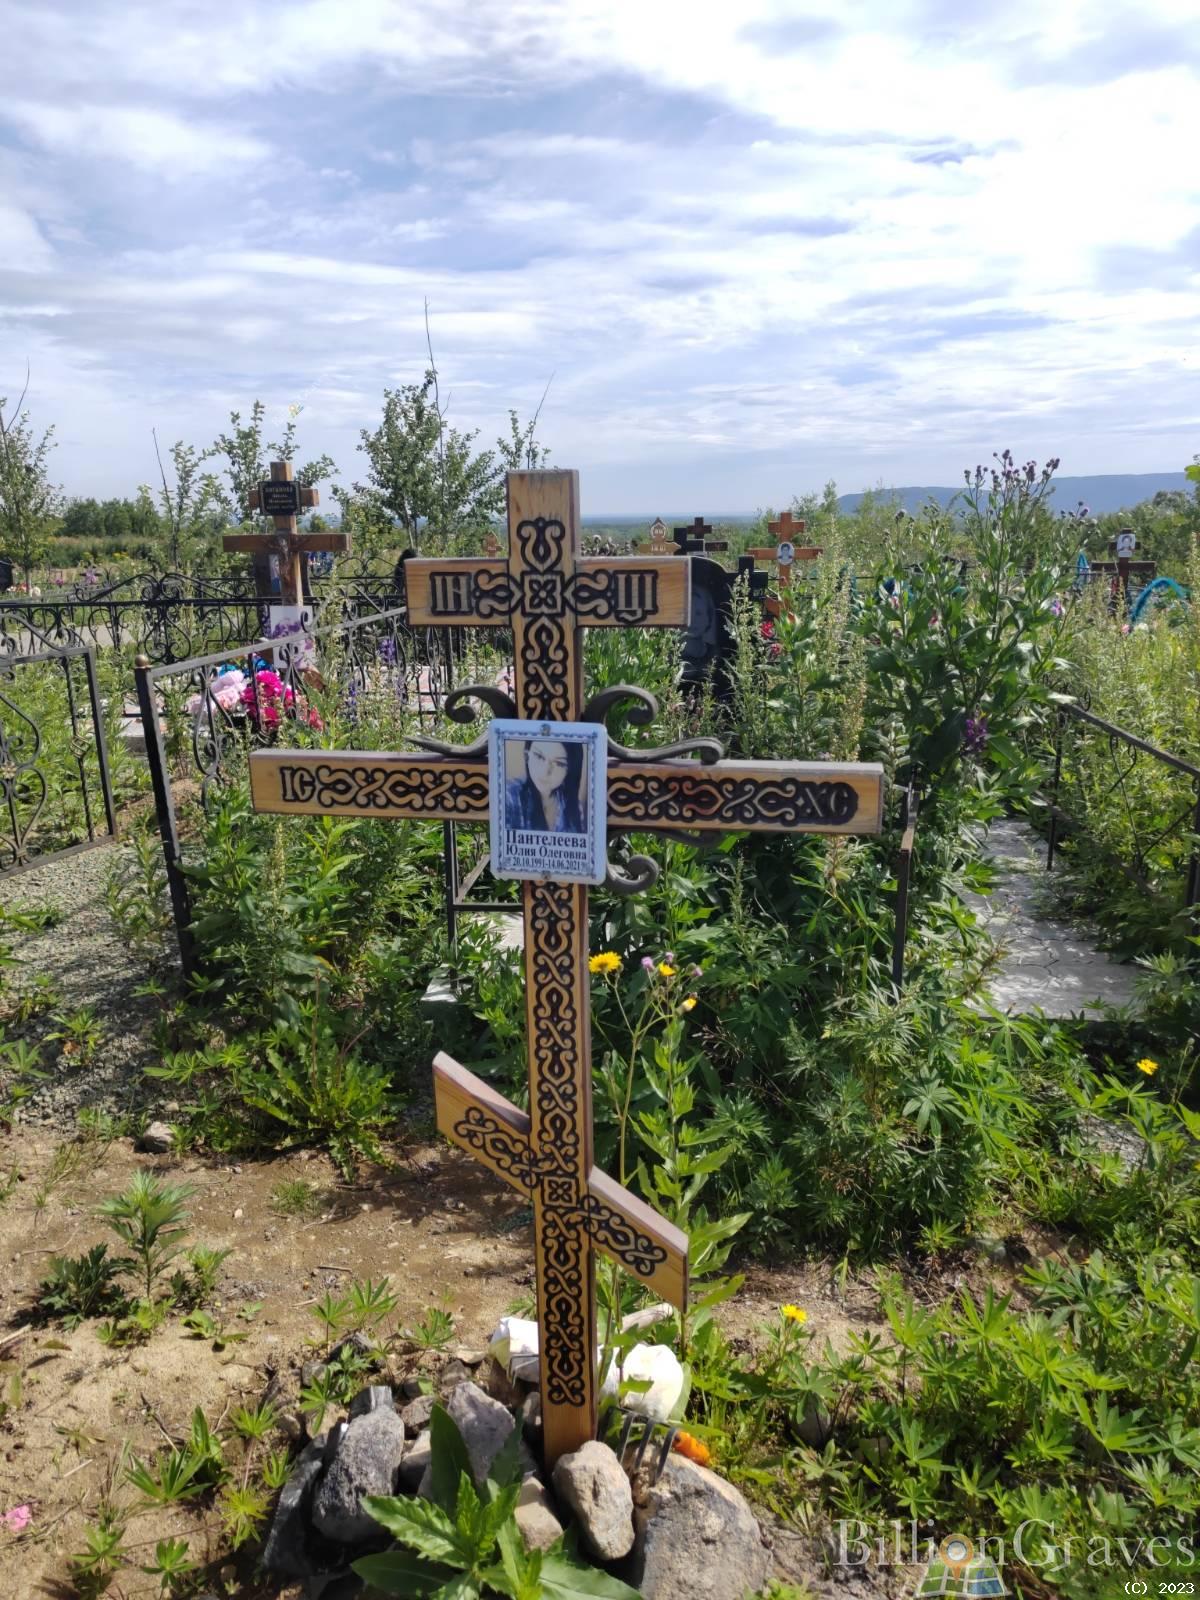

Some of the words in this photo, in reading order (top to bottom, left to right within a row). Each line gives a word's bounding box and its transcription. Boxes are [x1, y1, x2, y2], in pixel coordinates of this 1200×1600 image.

[506, 829, 587, 848] Пантелеева
[506, 844, 536, 857] Юлия
[539, 846, 587, 860] Олеговна
